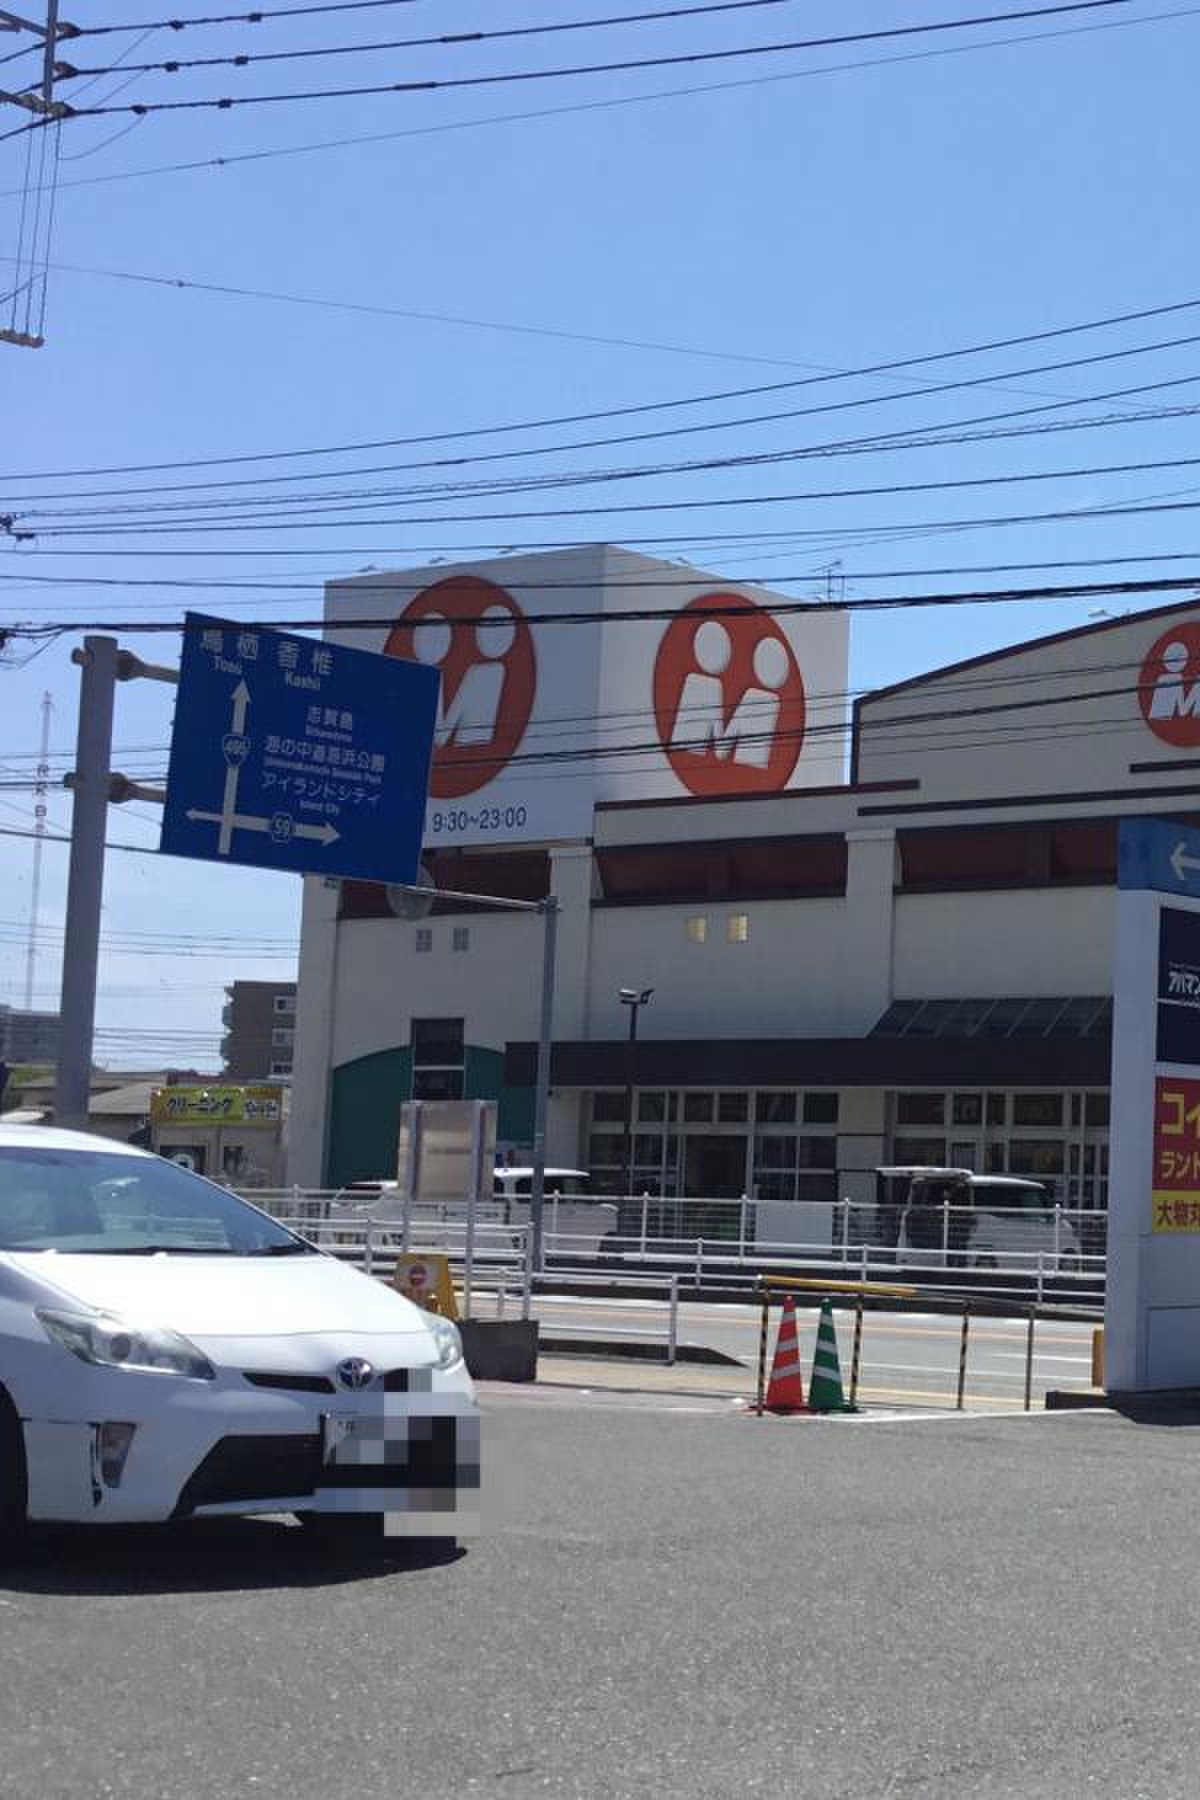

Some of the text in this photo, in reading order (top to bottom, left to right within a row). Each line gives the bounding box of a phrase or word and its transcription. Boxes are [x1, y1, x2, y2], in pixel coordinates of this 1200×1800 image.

[261, 769, 382, 807] アイランドシティ
[167, 1096, 233, 1115] クリーニング
